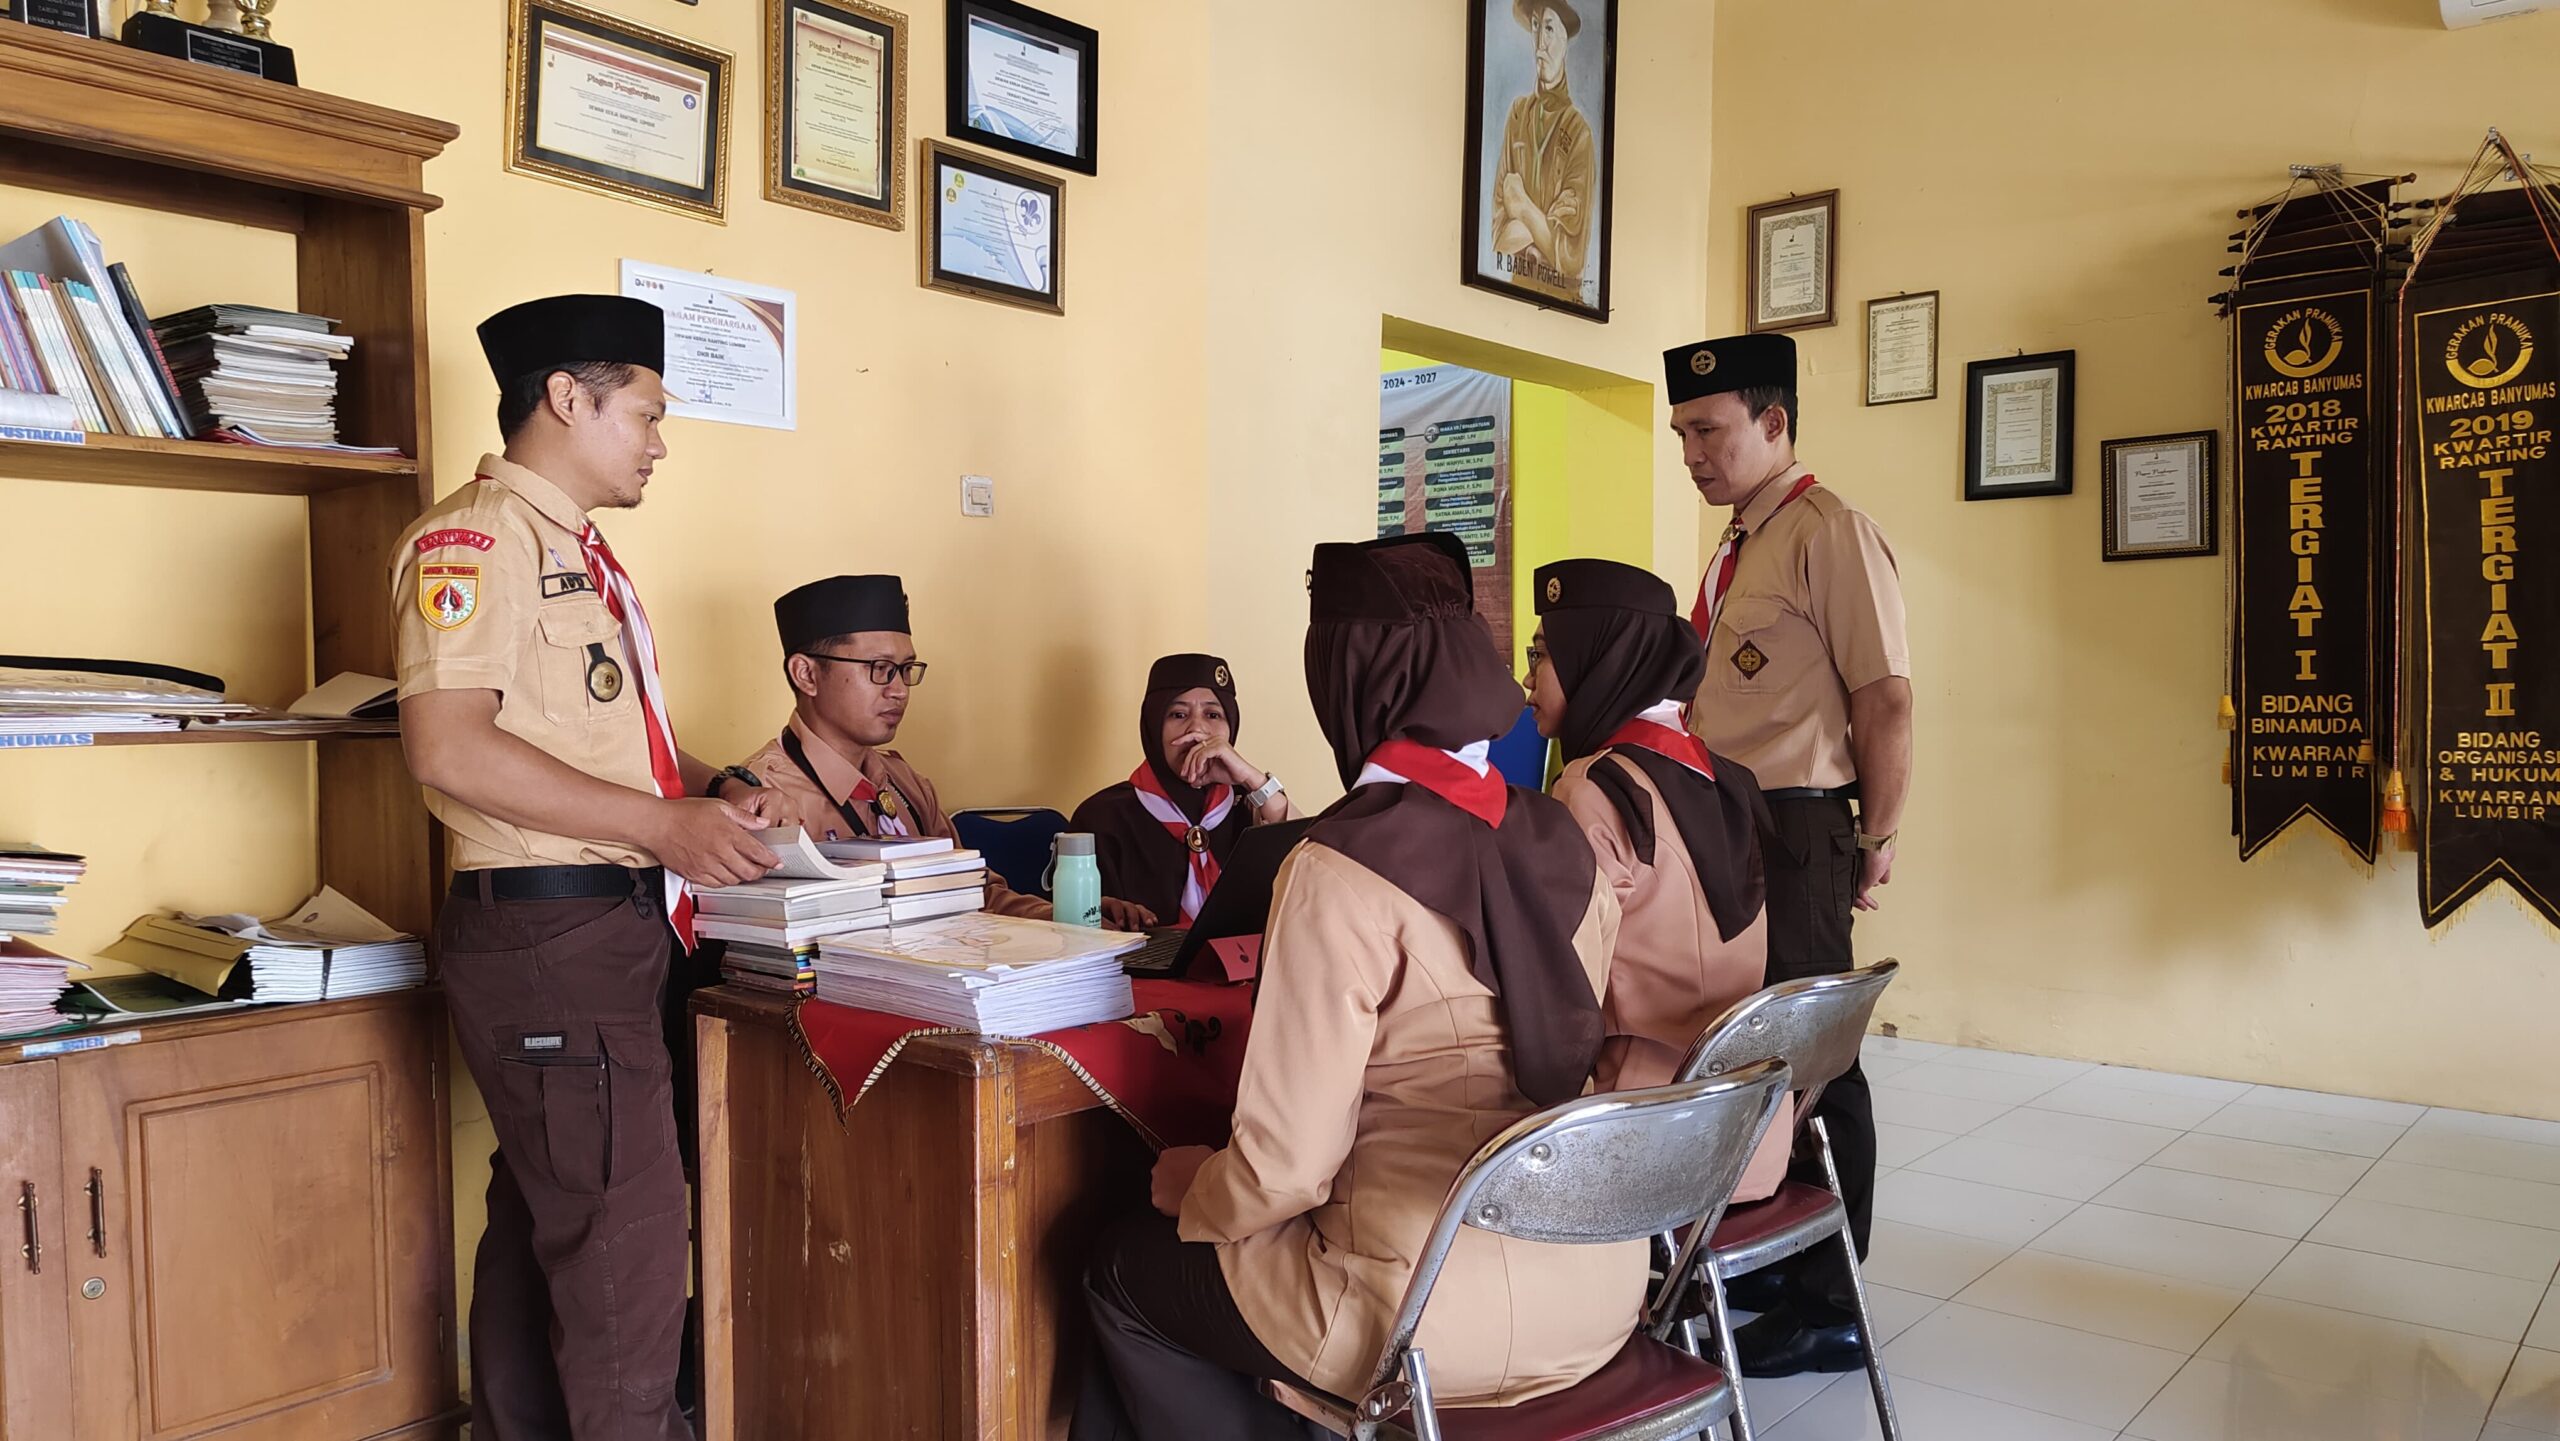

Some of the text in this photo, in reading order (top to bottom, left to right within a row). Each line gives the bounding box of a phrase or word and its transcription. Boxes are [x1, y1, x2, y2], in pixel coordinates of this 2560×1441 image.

[1506, 254, 1534, 278] BADEN
[1537, 264, 1567, 289] POWELL
[2264, 307, 2343, 350] GERAKAN PRAMUKA
[2446, 313, 2534, 360] GERAKAN PRAMUKA
[146, 329, 162, 351] ISLAM
[1383, 376, 1405, 389] 2024
[1415, 372, 1437, 385] 2027
[2245, 373, 2363, 400] KWARCAB BANYUMAS
[2426, 381, 2556, 414] KWARCAB BANYUMAS
[2265, 399, 2342, 424] 2018
[2251, 417, 2359, 439] KWARTIR
[2450, 410, 2534, 439] 2019
[2256, 431, 2353, 451] RANTING
[2433, 430, 2552, 456] KWARTIR
[2440, 446, 2547, 470] RANTING
[2288, 451, 2326, 681] TERGIAT I
[2479, 468, 2519, 717] TERGIAT II
[2261, 694, 2353, 714] BIDANG
[2251, 718, 2364, 735] BINAMUDA
[0, 733, 92, 746] HUMAS
[2457, 731, 2541, 748] BIDANG
[2253, 745, 2361, 762] KWARRAN
[2252, 765, 2365, 778] LUMBIR
[2439, 767, 2560, 782] & HUKUM
[2439, 789, 2560, 806] KWARRAN
[2455, 805, 2546, 822] LUMBIR
